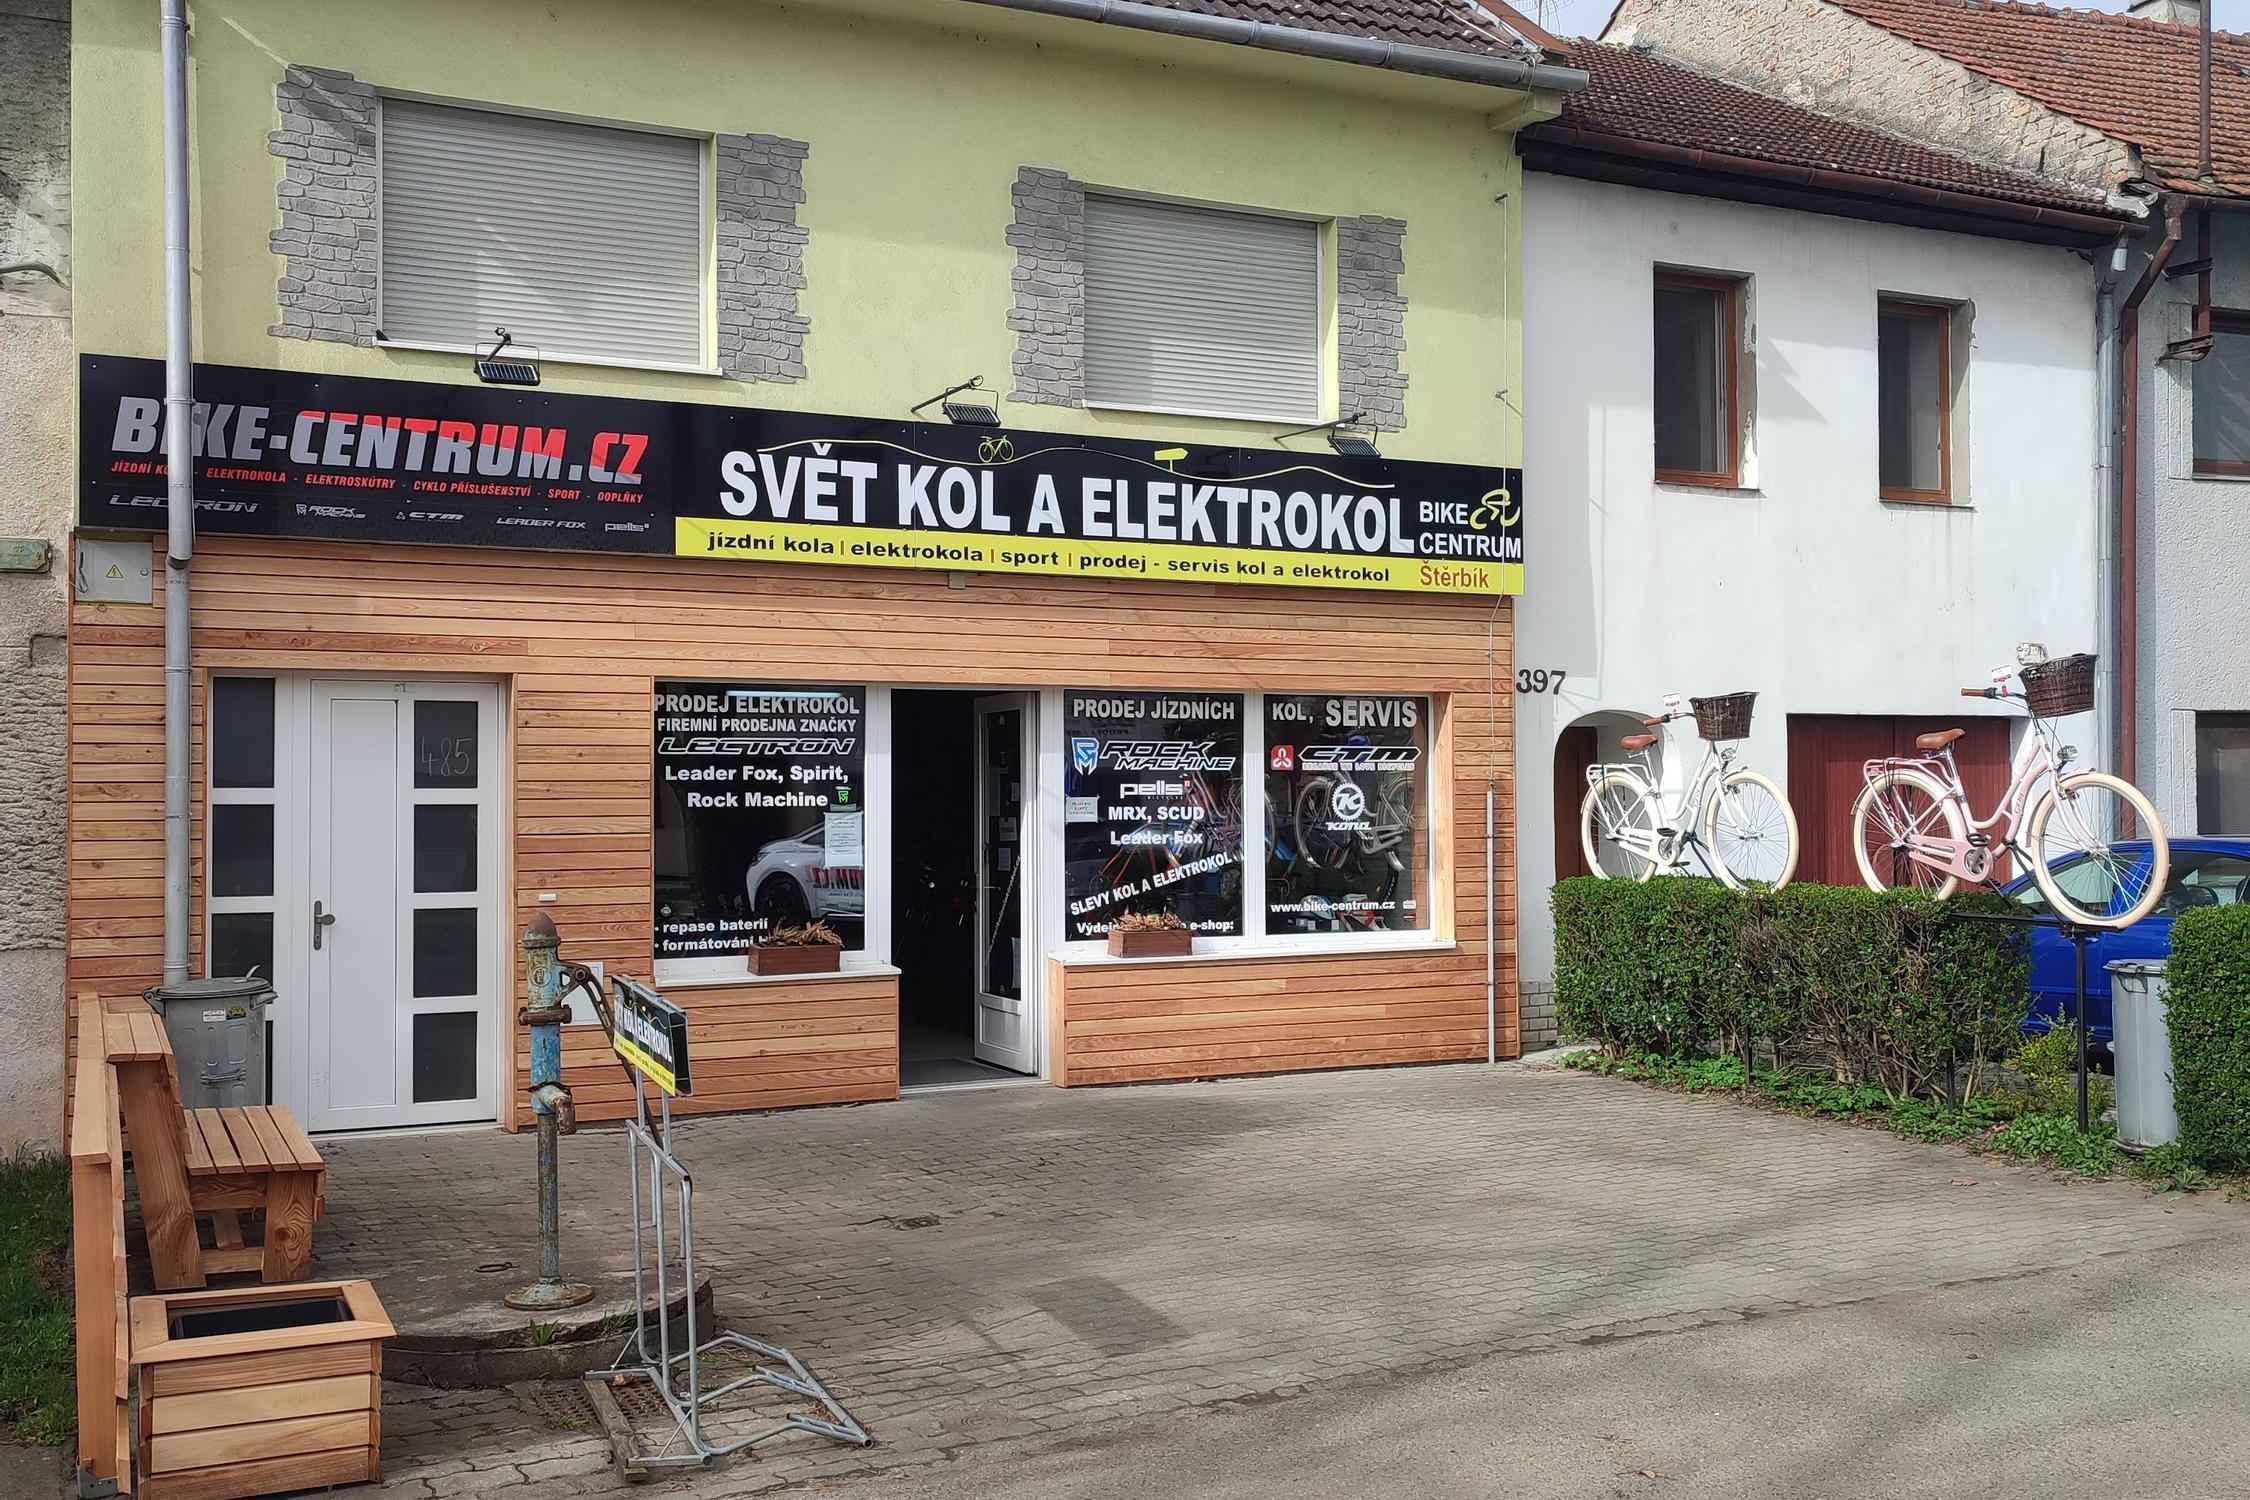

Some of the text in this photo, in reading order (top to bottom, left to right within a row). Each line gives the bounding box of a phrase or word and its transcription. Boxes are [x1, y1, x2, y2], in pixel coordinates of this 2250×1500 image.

[110, 396, 649, 485] BKE-CENTRUM.CZ
[111, 460, 152, 474] JÍZDNÍ
[206, 467, 287, 483] ELEKTROKOLA
[305, 473, 396, 490] ELEKTROSKÚTRY
[413, 480, 447, 493] CYKLO
[450, 480, 533, 498] PŘÍSLUŠENSTVÍ
[547, 488, 582, 501] SPORT
[597, 490, 644, 504] DOPLŇKY
[719, 442, 1414, 554] SVĚT KOL A ELEKTROKOL
[1419, 500, 1469, 525] BIKE
[556, 519, 587, 530] FOX
[1419, 532, 1521, 559] CENTRUM
[707, 531, 774, 551] jízdní
[783, 536, 835, 555] kola
[850, 542, 983, 562] elektrokola
[1001, 550, 1059, 567] sport
[1080, 553, 1146, 573] prodej
[1167, 559, 1229, 574] servis
[1236, 560, 1266, 576] kol
[1273, 565, 1284, 577] a
[1292, 564, 1390, 583] elektrokol
[1419, 560, 1490, 589] Štěrbík
[1516, 669, 1566, 695] 397
[654, 694, 860, 714] PRODEJ ELEKTROKOL
[1073, 696, 1235, 720] PRODEJ JÍZDNÍCH
[1272, 699, 1418, 728] KOL, SERVIS
[657, 715, 857, 733] FIREMNÍ PRODEJNA ZNAČKY
[1099, 740, 1216, 759] ROCK
[1113, 756, 1237, 771] MACHINE
[665, 765, 849, 784] Leader Fox, Spirit,
[1120, 780, 1183, 799] pells
[687, 792, 739, 808] Rock
[745, 792, 828, 808] Machine
[1108, 806, 1152, 823] MRX,
[1157, 806, 1205, 821] SCUD
[1110, 830, 1203, 845] Leader Fox
[1070, 851, 1233, 916] SLEVY KOL A ELEKTROKOL
[1270, 900, 1396, 913] www.bike-centrum.cz
[663, 917, 768, 936] repase baterií
[1190, 919, 1234, 933] e-shop:
